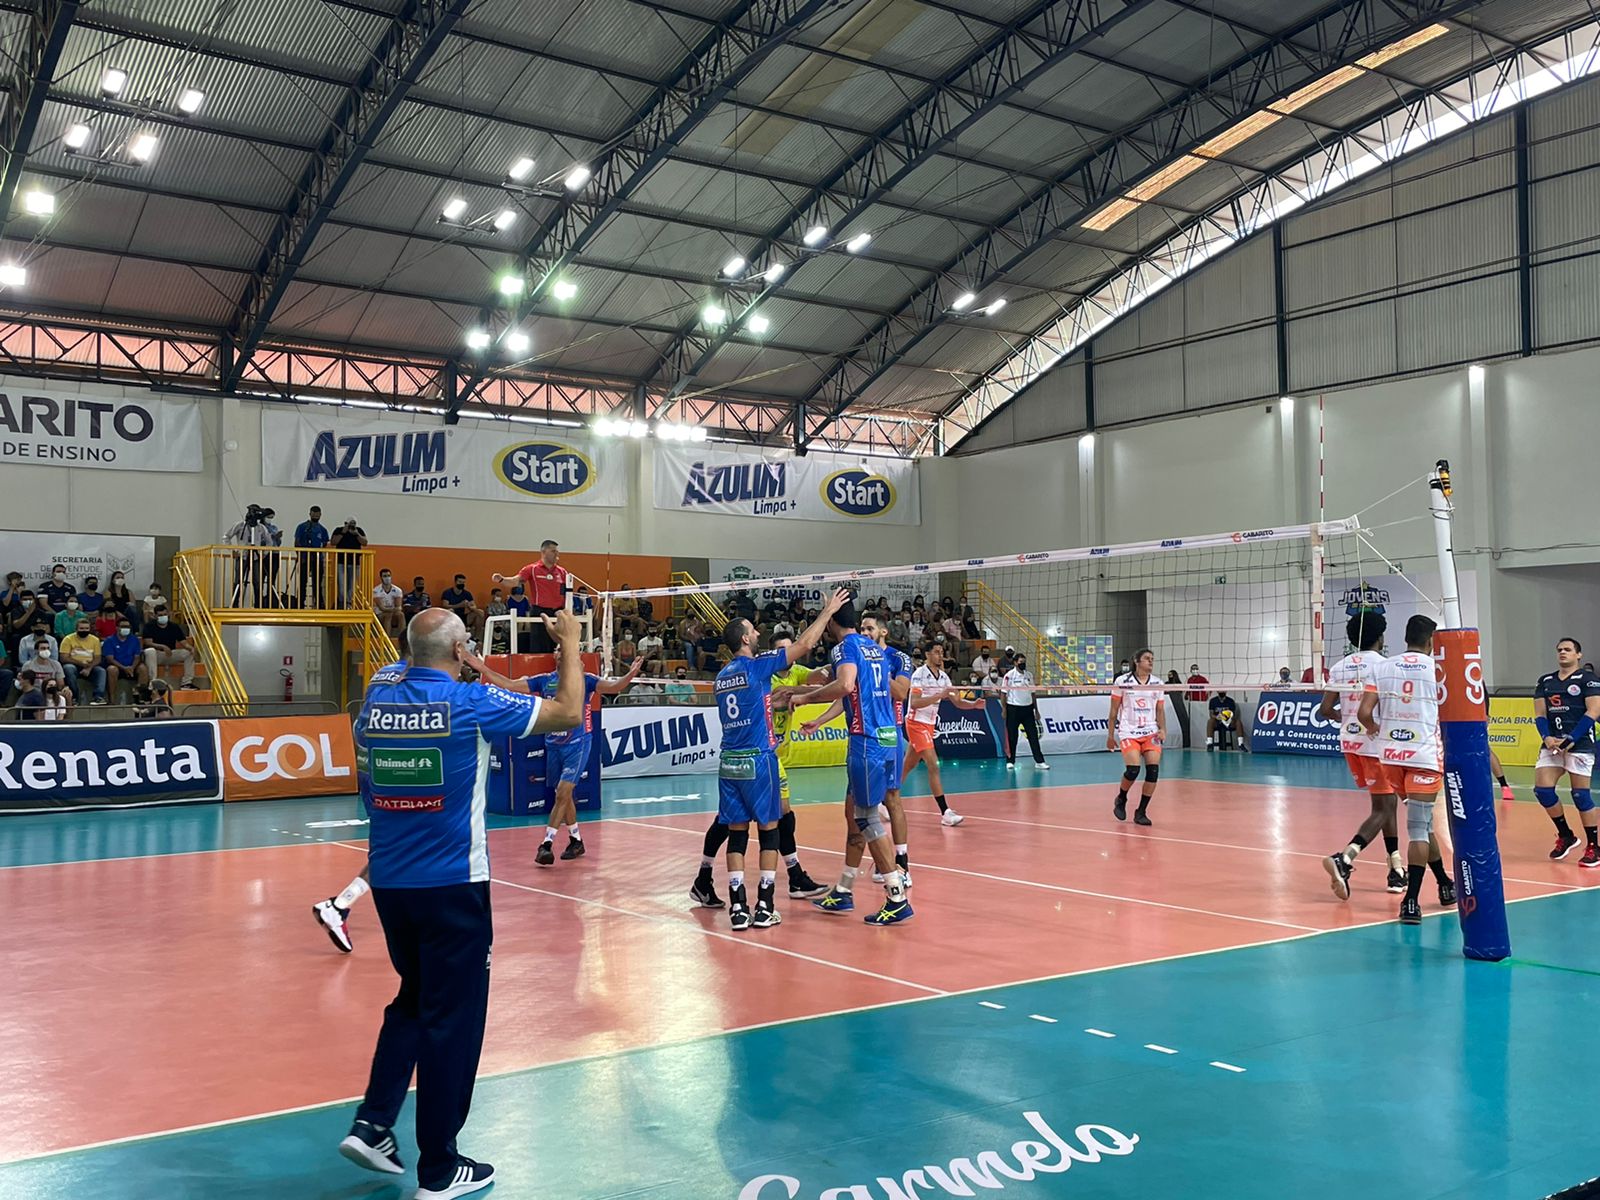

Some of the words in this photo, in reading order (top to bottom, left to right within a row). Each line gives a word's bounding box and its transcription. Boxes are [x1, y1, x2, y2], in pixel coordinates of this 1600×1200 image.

[3, 442, 30, 457] DE
[37, 444, 117, 462] ENSINO
[304, 429, 448, 482] AZULIM
[512, 450, 579, 486] Start
[402, 475, 448, 494] Limpa
[681, 461, 786, 507] AZULIM
[834, 477, 886, 507] Start
[753, 499, 787, 516] Limpa
[52, 556, 103, 564] SECRETARIA
[1338, 590, 1391, 606] JOVENS
[716, 675, 746, 691] Renata
[1463, 645, 1485, 705] GOL
[726, 693, 740, 720] 8
[368, 708, 445, 731] Renata
[723, 718, 752, 730] GONZALEZ
[1045, 716, 1119, 734] Eurofarma
[601, 712, 710, 768] AZULIM
[942, 737, 979, 745] MASCULINA
[1253, 729, 1276, 737] Pisos
[1391, 729, 1413, 740] Start
[1276, 741, 1341, 751] www.recoma.c
[0, 739, 206, 790] Renata
[229, 734, 350, 783] GOL
[375, 758, 415, 768] Unimed
[671, 750, 706, 766] Limpa
[1446, 772, 1467, 820] AZULIM
[1461, 860, 1472, 896] GABARITO
